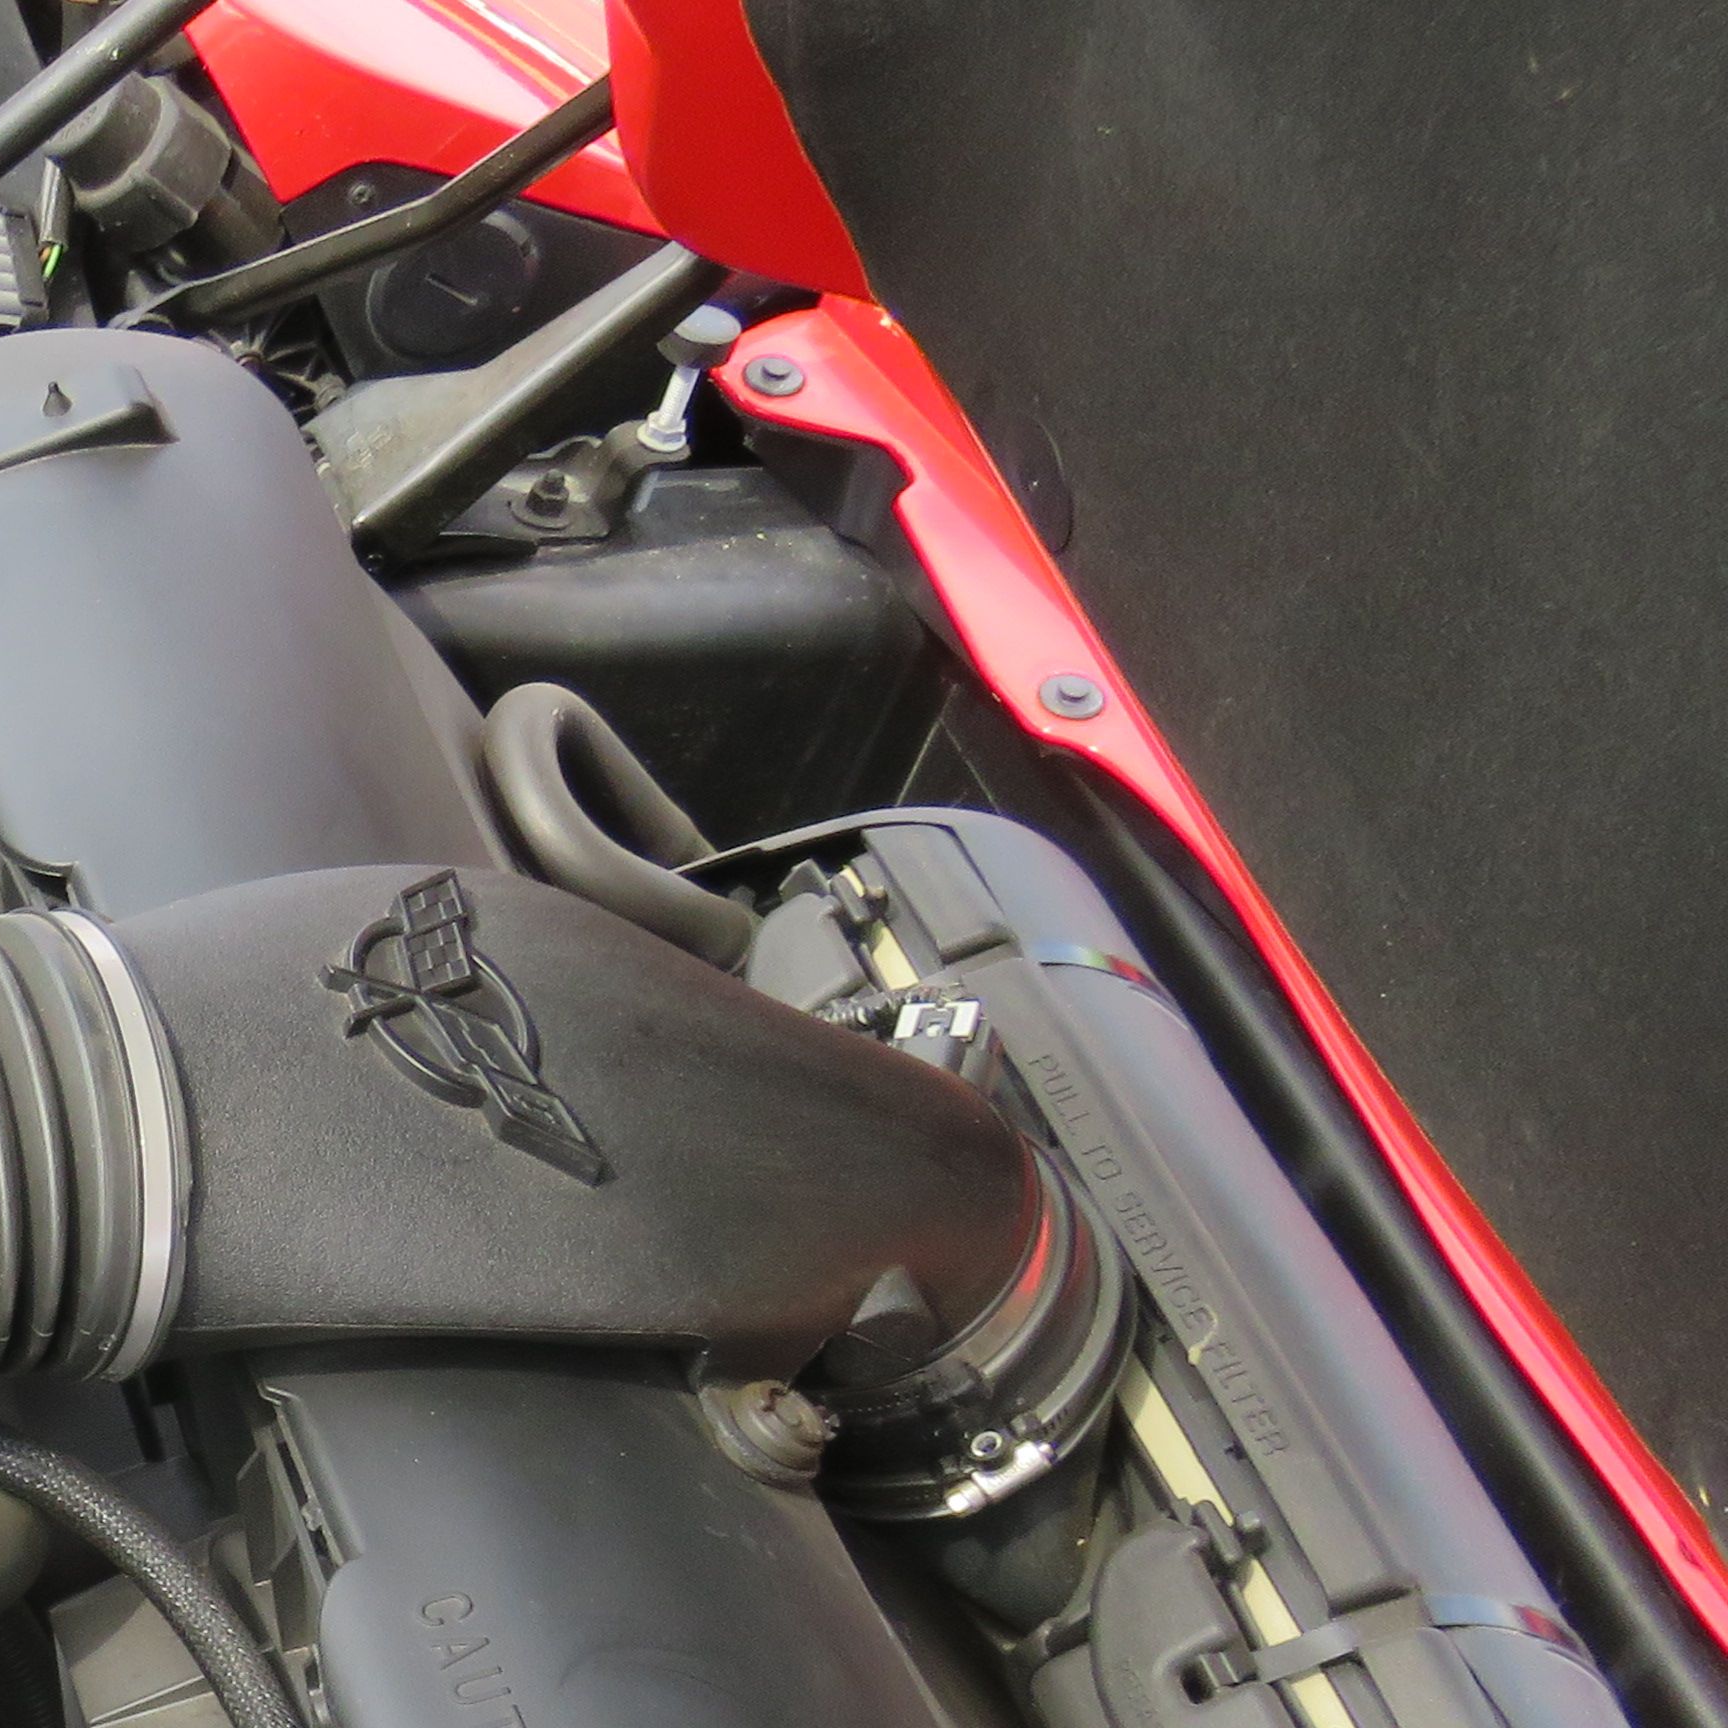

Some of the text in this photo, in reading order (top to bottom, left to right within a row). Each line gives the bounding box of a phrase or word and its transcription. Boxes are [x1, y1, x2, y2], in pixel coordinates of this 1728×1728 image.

[1028, 1054, 1291, 1458] PULL TO SERVICE FILTER
